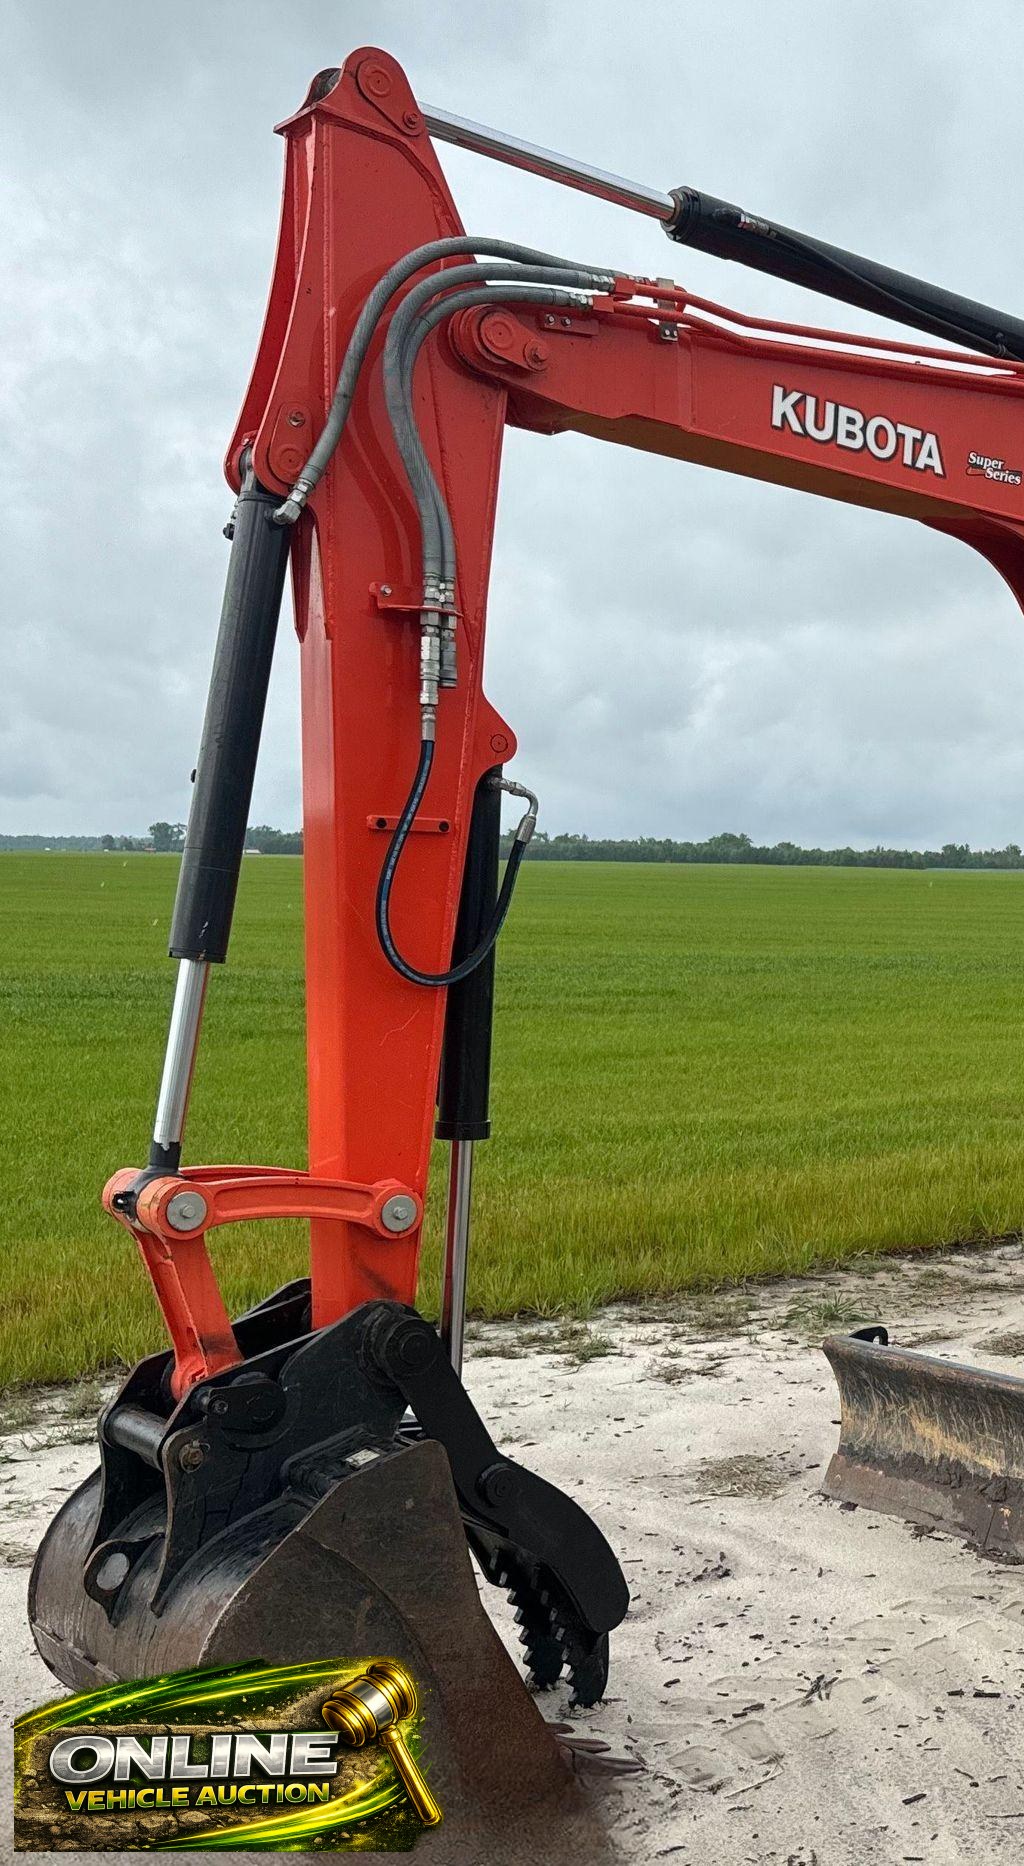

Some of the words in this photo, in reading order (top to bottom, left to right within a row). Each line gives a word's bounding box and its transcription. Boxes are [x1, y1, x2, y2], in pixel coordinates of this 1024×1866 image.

[770, 384, 945, 476] KUBOTA
[968, 451, 1005, 470] Super
[984, 467, 1022, 485] Series
